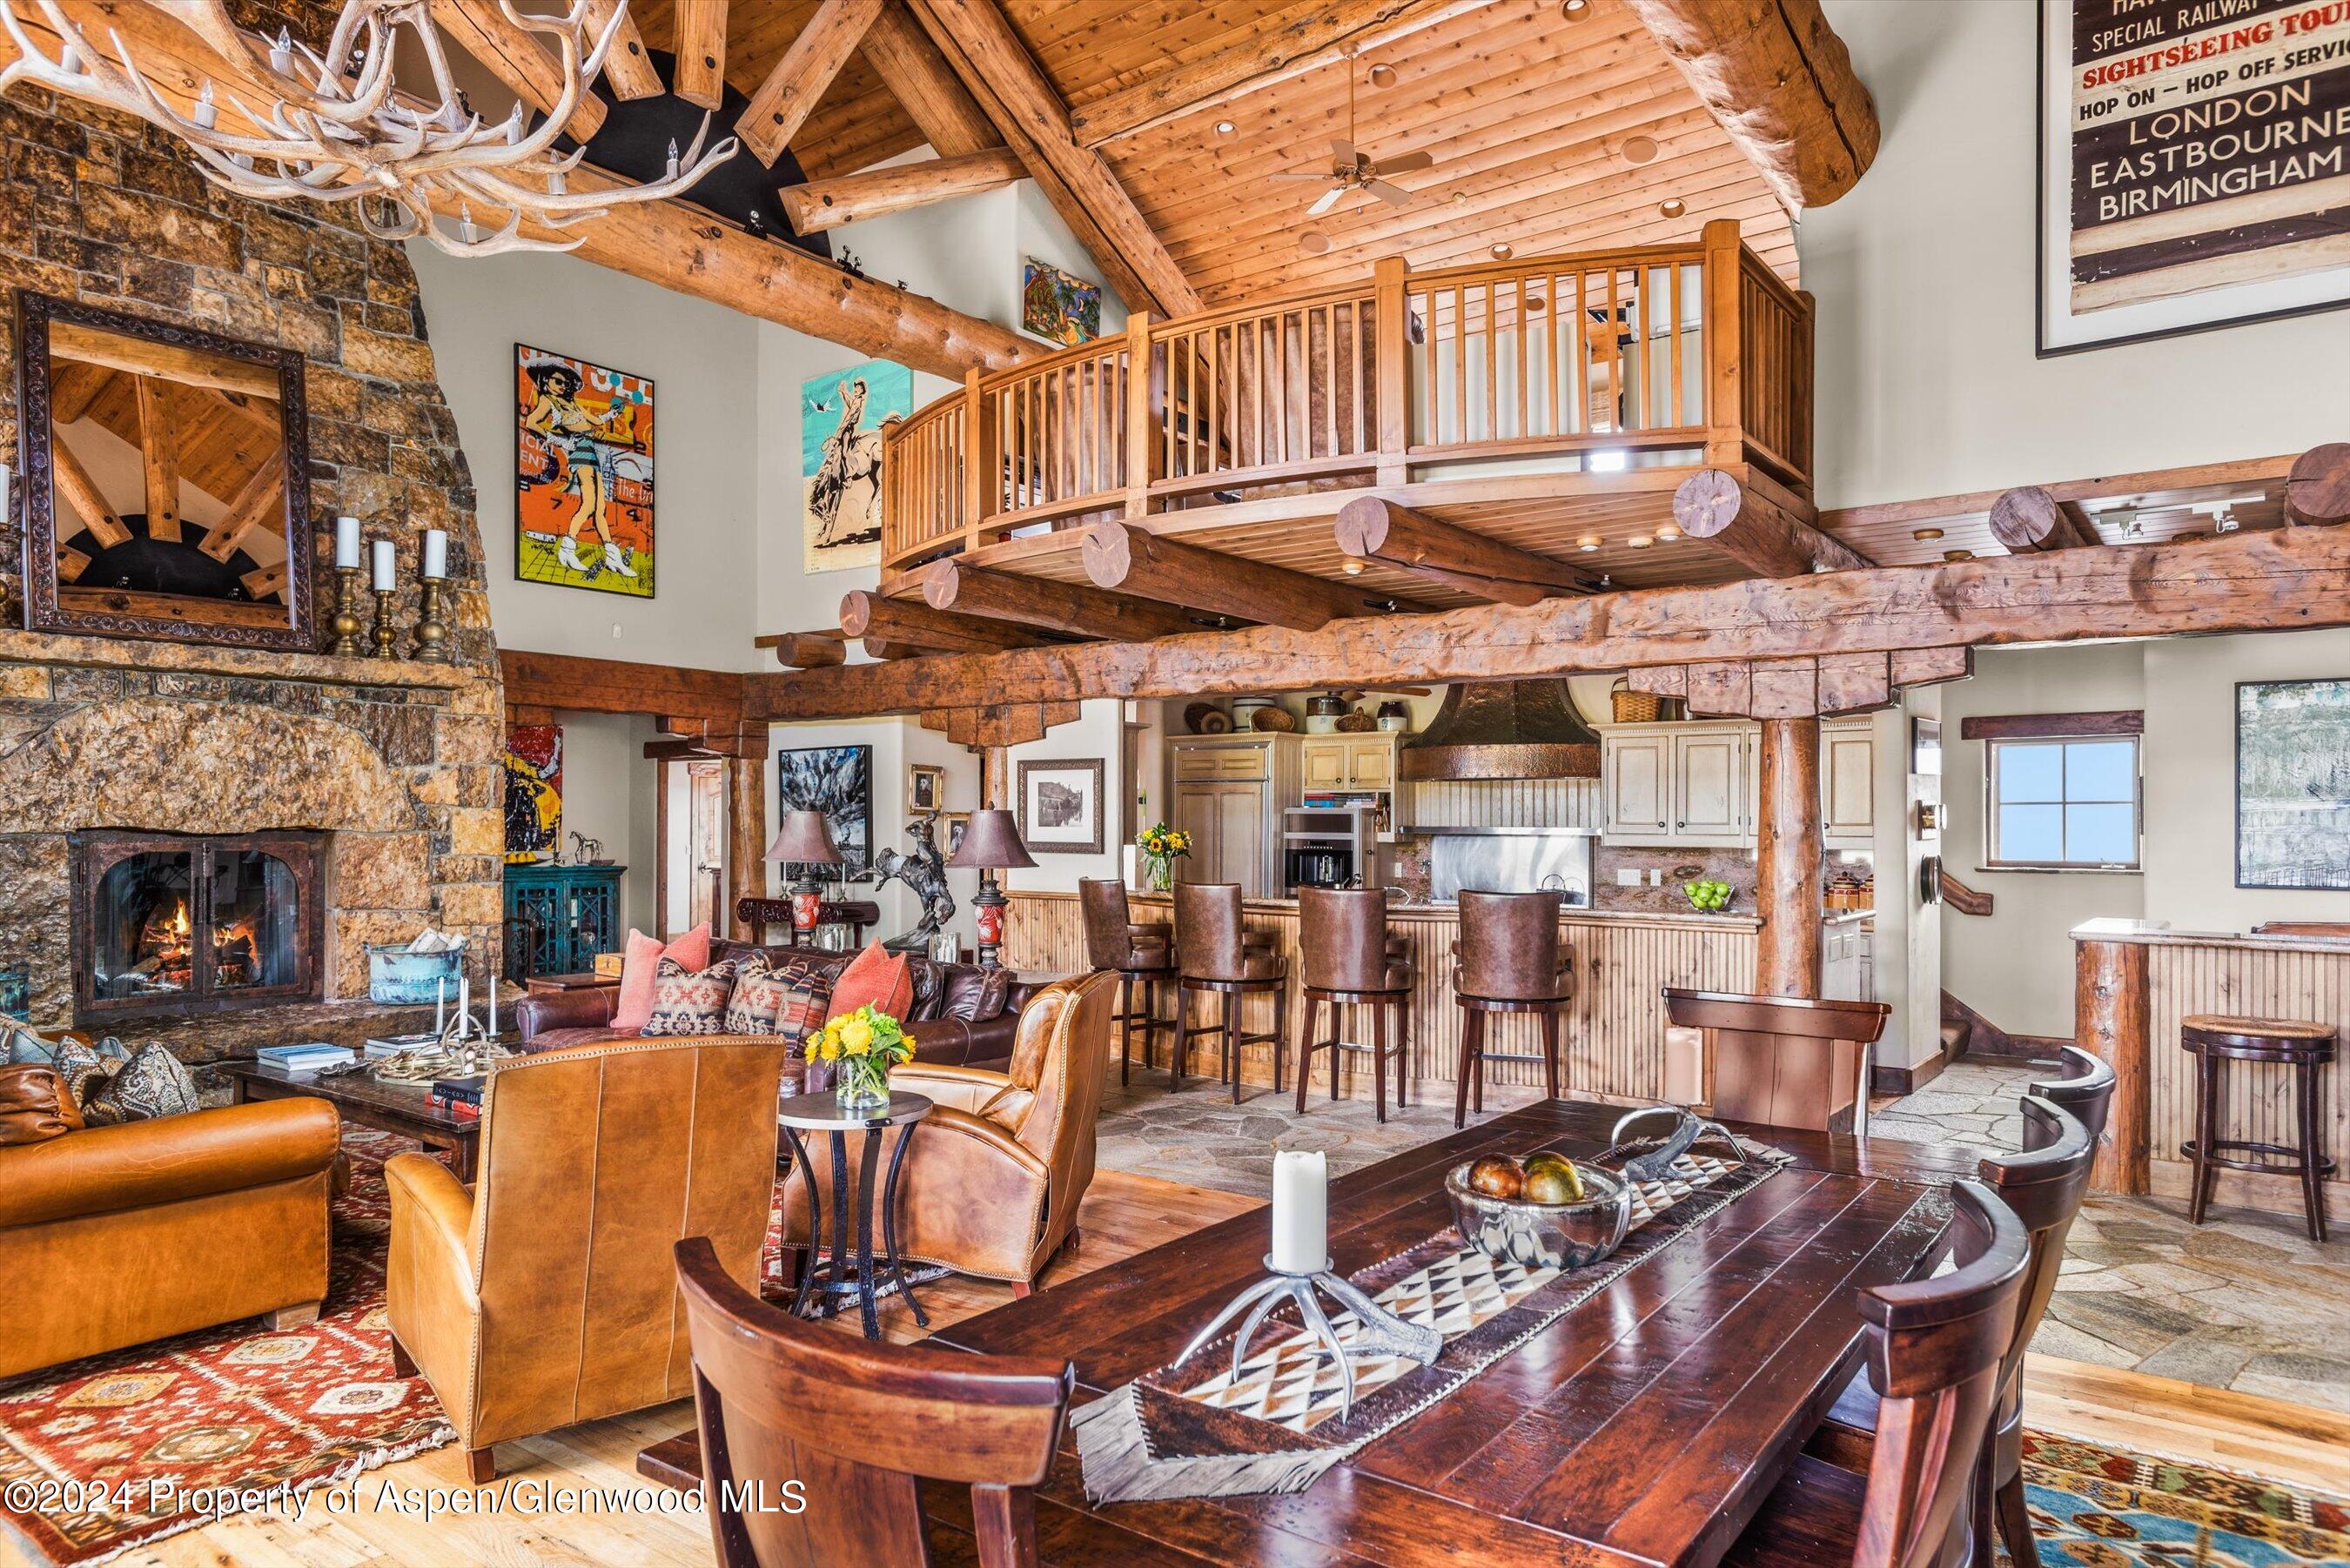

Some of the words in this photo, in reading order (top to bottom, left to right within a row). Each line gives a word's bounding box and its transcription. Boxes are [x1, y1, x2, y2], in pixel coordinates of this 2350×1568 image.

[2083, 22, 2274, 90] SIGHTSEEING
[2092, 16, 2165, 53] SPECIAL
[2080, 97, 2118, 121] HOP
[2128, 87, 2155, 109] ON
[2186, 70, 2229, 95] HOP
[2239, 57, 2275, 81] OFF
[2130, 79, 2311, 145] LONDON
[2091, 106, 2350, 189] EASTBOURNE
[2099, 145, 2342, 221] BIRMINGHAM
[618, 479, 635, 499] The
